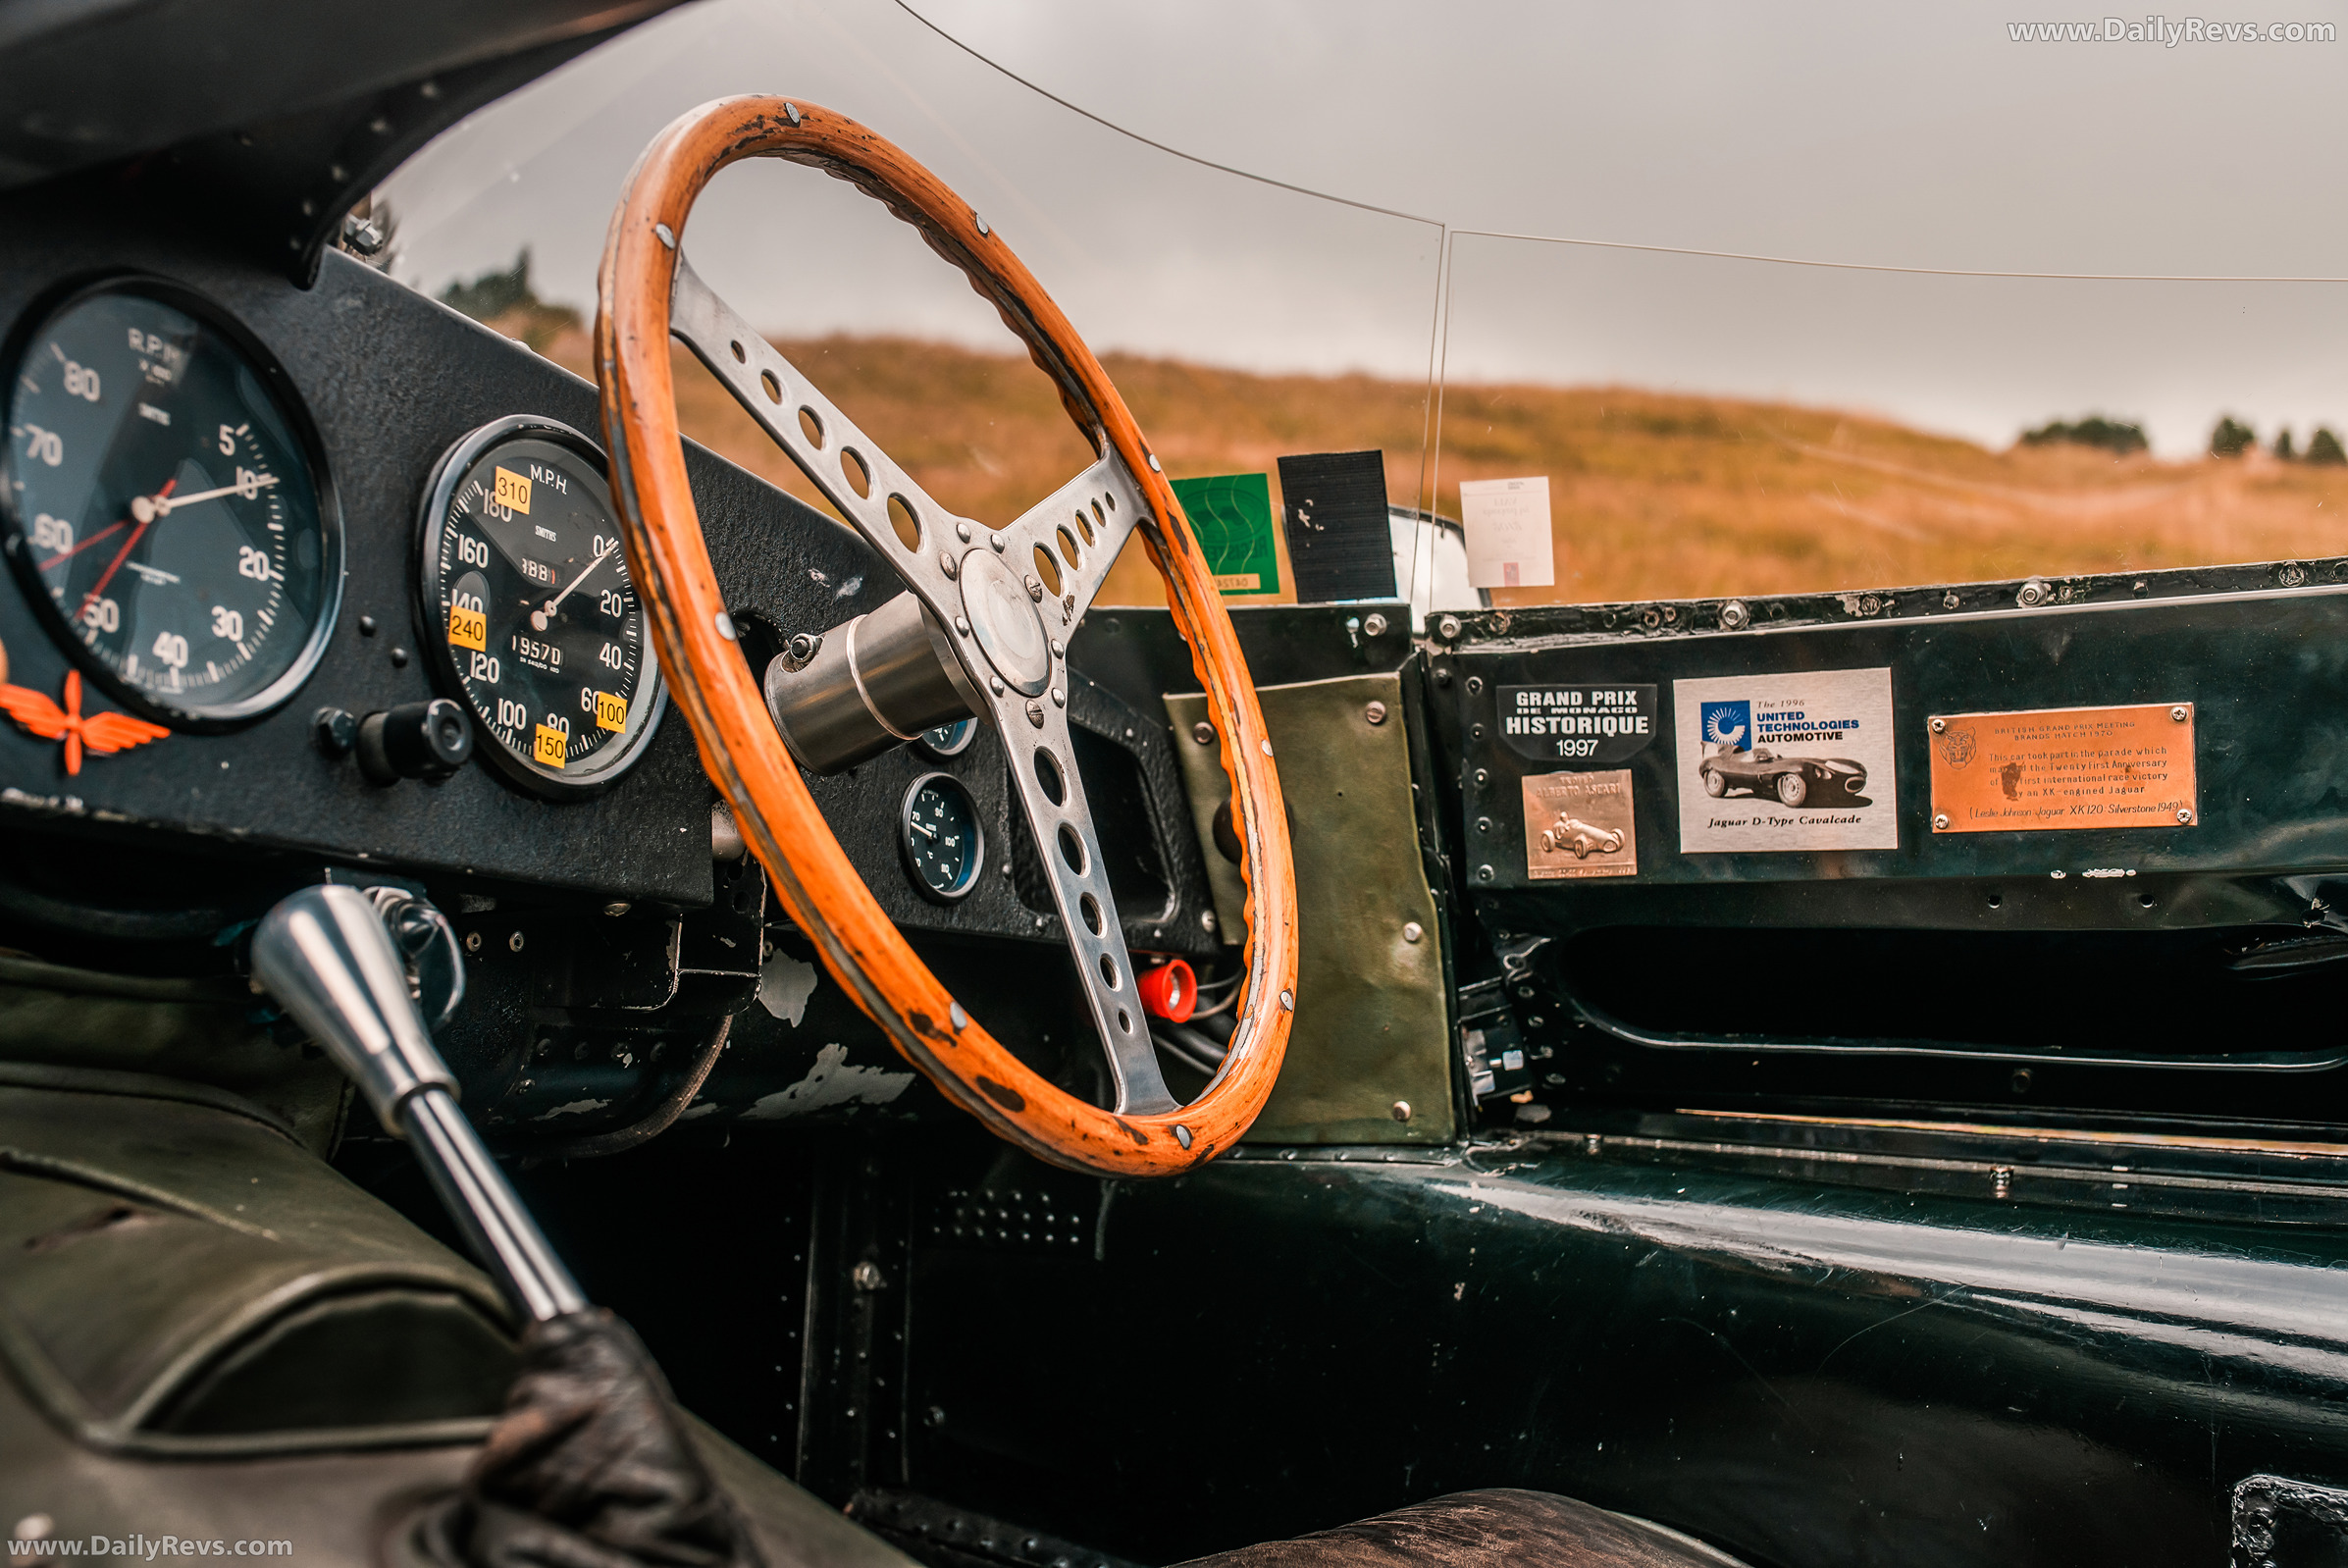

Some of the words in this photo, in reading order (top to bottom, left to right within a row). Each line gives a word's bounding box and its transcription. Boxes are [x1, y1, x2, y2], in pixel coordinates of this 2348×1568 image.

[64, 360, 101, 402] 80
[25, 423, 63, 467] 70
[219, 424, 235, 456] 5
[236, 465, 258, 500] 10
[497, 477, 528, 504] 310
[34, 513, 74, 554] 60
[535, 525, 557, 543] SMITHS
[457, 533, 489, 568] 160
[593, 535, 604, 557] 0
[238, 546, 270, 581] 20
[600, 589, 622, 618] 20
[211, 605, 243, 642] 30
[451, 615, 484, 642] 240
[152, 631, 188, 668] 40
[600, 642, 622, 670] 40
[470, 651, 500, 684] 120
[1516, 691, 1583, 706] GRAND
[1591, 690, 1638, 706] PRIX
[1780, 699, 1805, 707] 1996
[497, 698, 527, 730] 100
[599, 702, 625, 725] 100
[1756, 711, 1805, 722] UNITED
[1505, 715, 1649, 737] HISTORIQUE
[1757, 719, 1859, 733] TECHNOLOGIES
[1757, 731, 1844, 743] AUTOMOTIVE
[537, 734, 564, 759] 150
[1556, 739, 1599, 757] 1997
[2050, 751, 2069, 759] part
[2080, 749, 2095, 758] the
[2098, 748, 2132, 758] parade
[2136, 747, 2167, 756] which
[2050, 762, 2086, 772] Twenty
[2112, 758, 2167, 768] Anniversary
[1990, 777, 1999, 786] of
[2044, 774, 2106, 784] international
[2132, 772, 2168, 782] victory
[2109, 785, 2145, 795] Jaguar
[912, 810, 920, 821] 70
[934, 808, 944, 817] 90
[1707, 816, 1748, 828] Jaguar
[1752, 816, 1795, 827] D-Type
[1799, 814, 1862, 825] Cavalcade
[945, 837, 956, 848] 100
